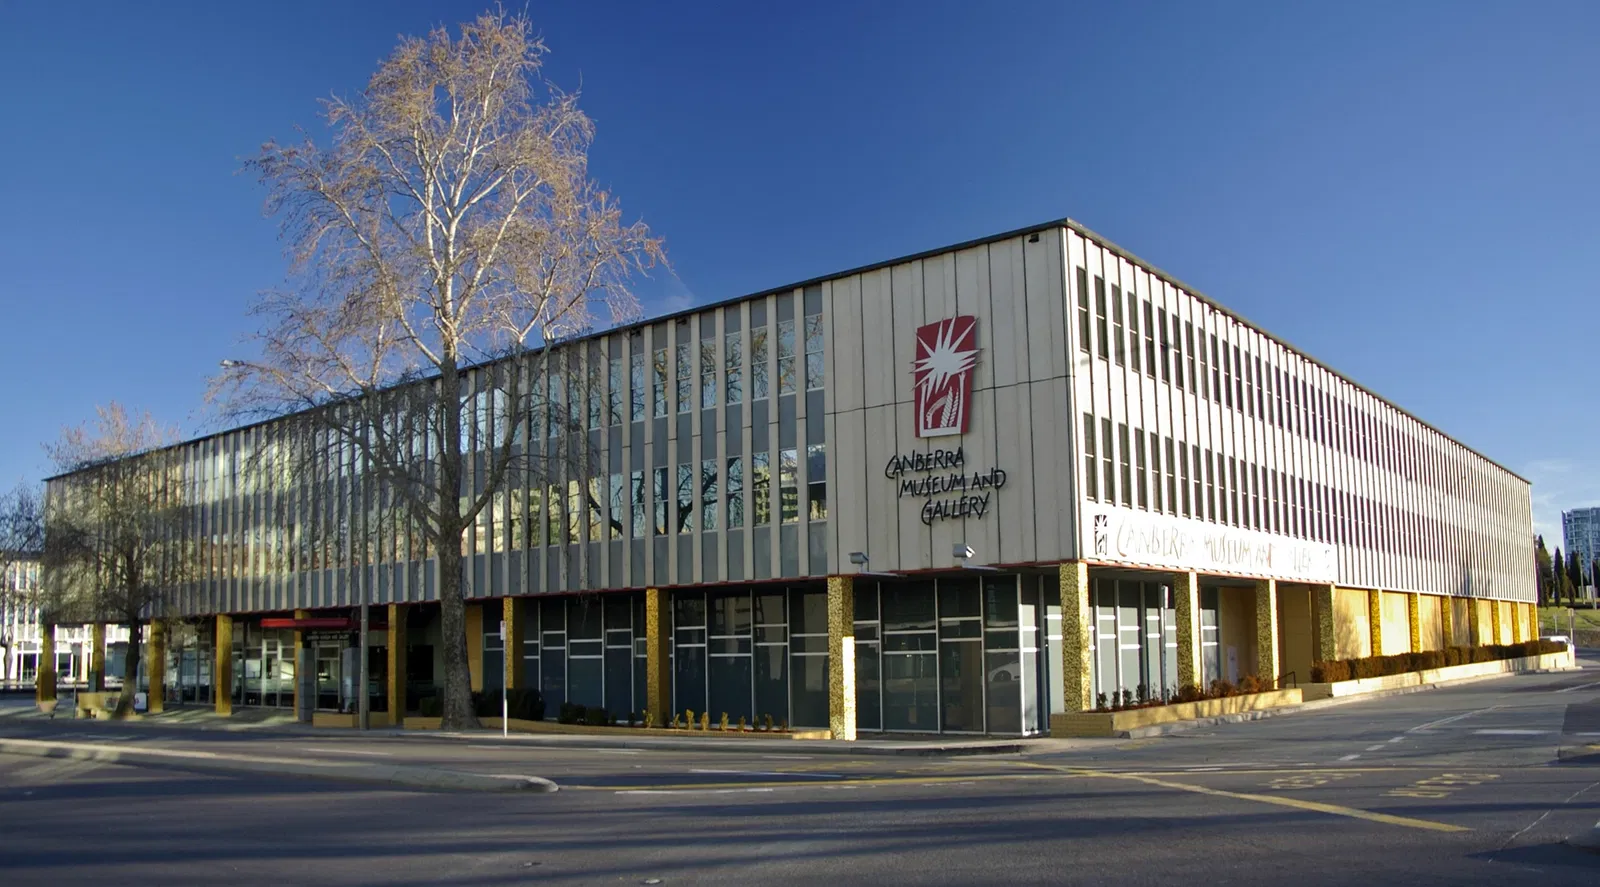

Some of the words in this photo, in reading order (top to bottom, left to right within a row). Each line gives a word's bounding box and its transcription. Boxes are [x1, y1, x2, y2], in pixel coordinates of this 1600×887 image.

[885, 447, 965, 479] CANBERRA
[899, 473, 966, 498] MUSEUM
[971, 467, 1006, 490] AND
[921, 492, 990, 526] GALLERY
[1116, 516, 1195, 560] CANBERR
[1202, 531, 1252, 568] MUSEUM
